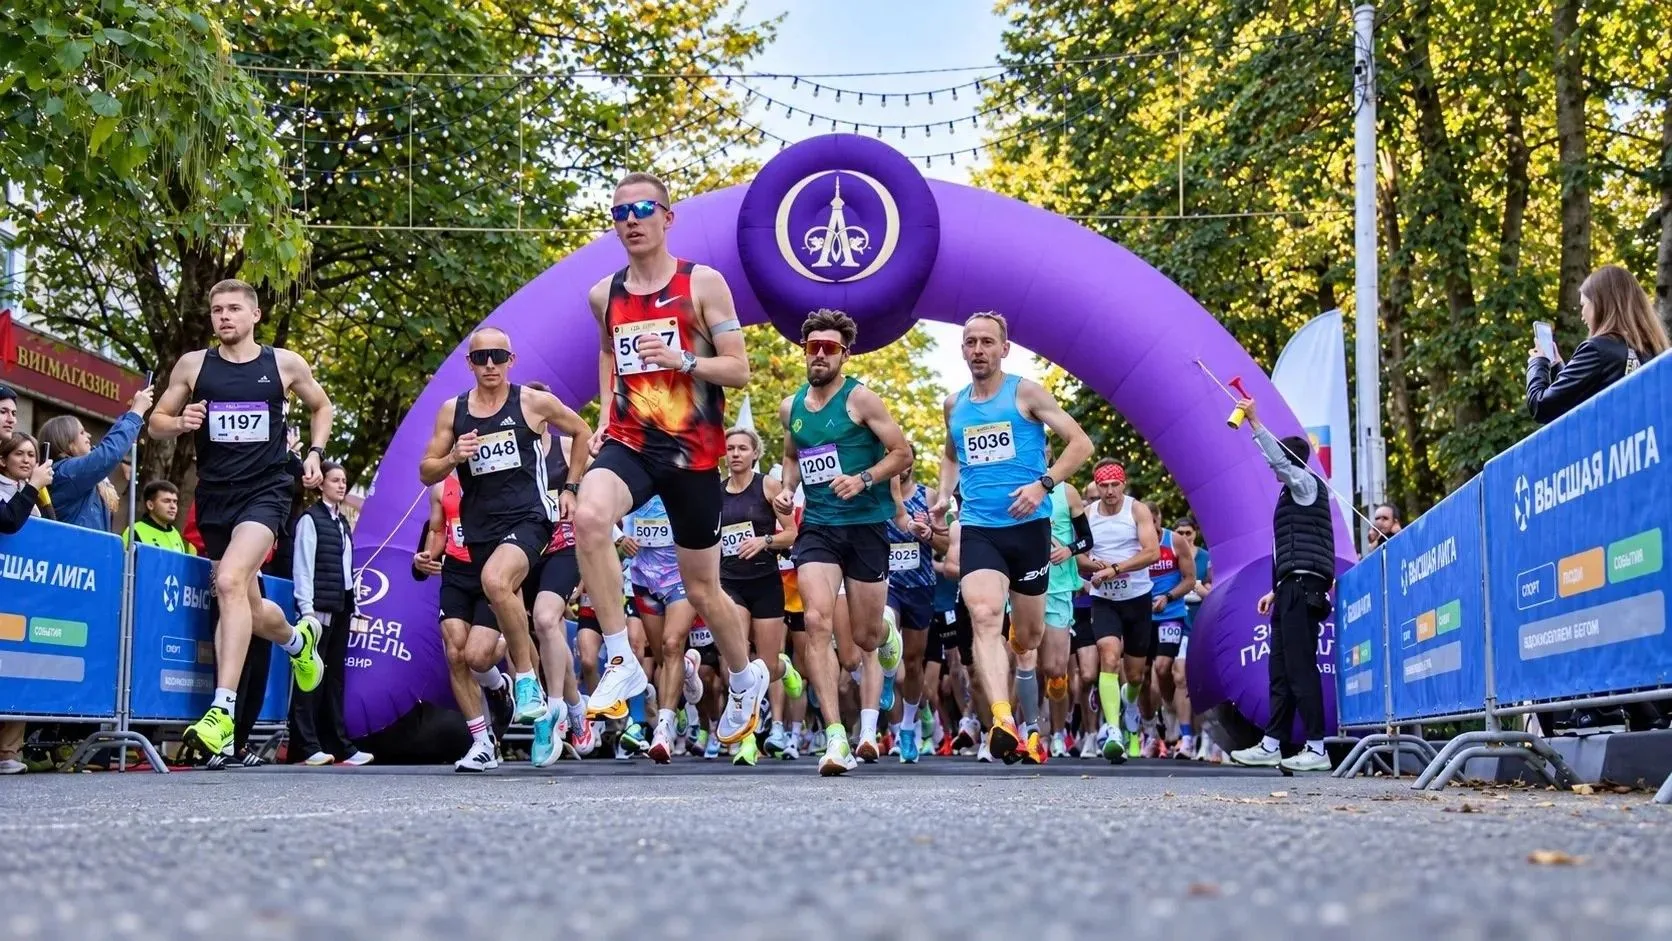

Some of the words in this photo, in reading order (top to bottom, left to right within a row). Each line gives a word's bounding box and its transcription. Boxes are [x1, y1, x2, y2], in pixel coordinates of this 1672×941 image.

[620, 331, 675, 356] 507
[218, 414, 262, 430] 1197
[968, 432, 1010, 451] 5036
[802, 455, 836, 474] 1200
[1534, 450, 1604, 515] ВЫСШАЯ
[1608, 425, 1661, 484] ЛИГА
[636, 526, 669, 538] 5079
[889, 550, 919, 561] 5025
[1408, 546, 1437, 587] ВЫСШАЯ
[1437, 535, 1457, 571] ЛИГА
[50, 563, 96, 592] ЛИГА
[1103, 579, 1128, 590] 1123
